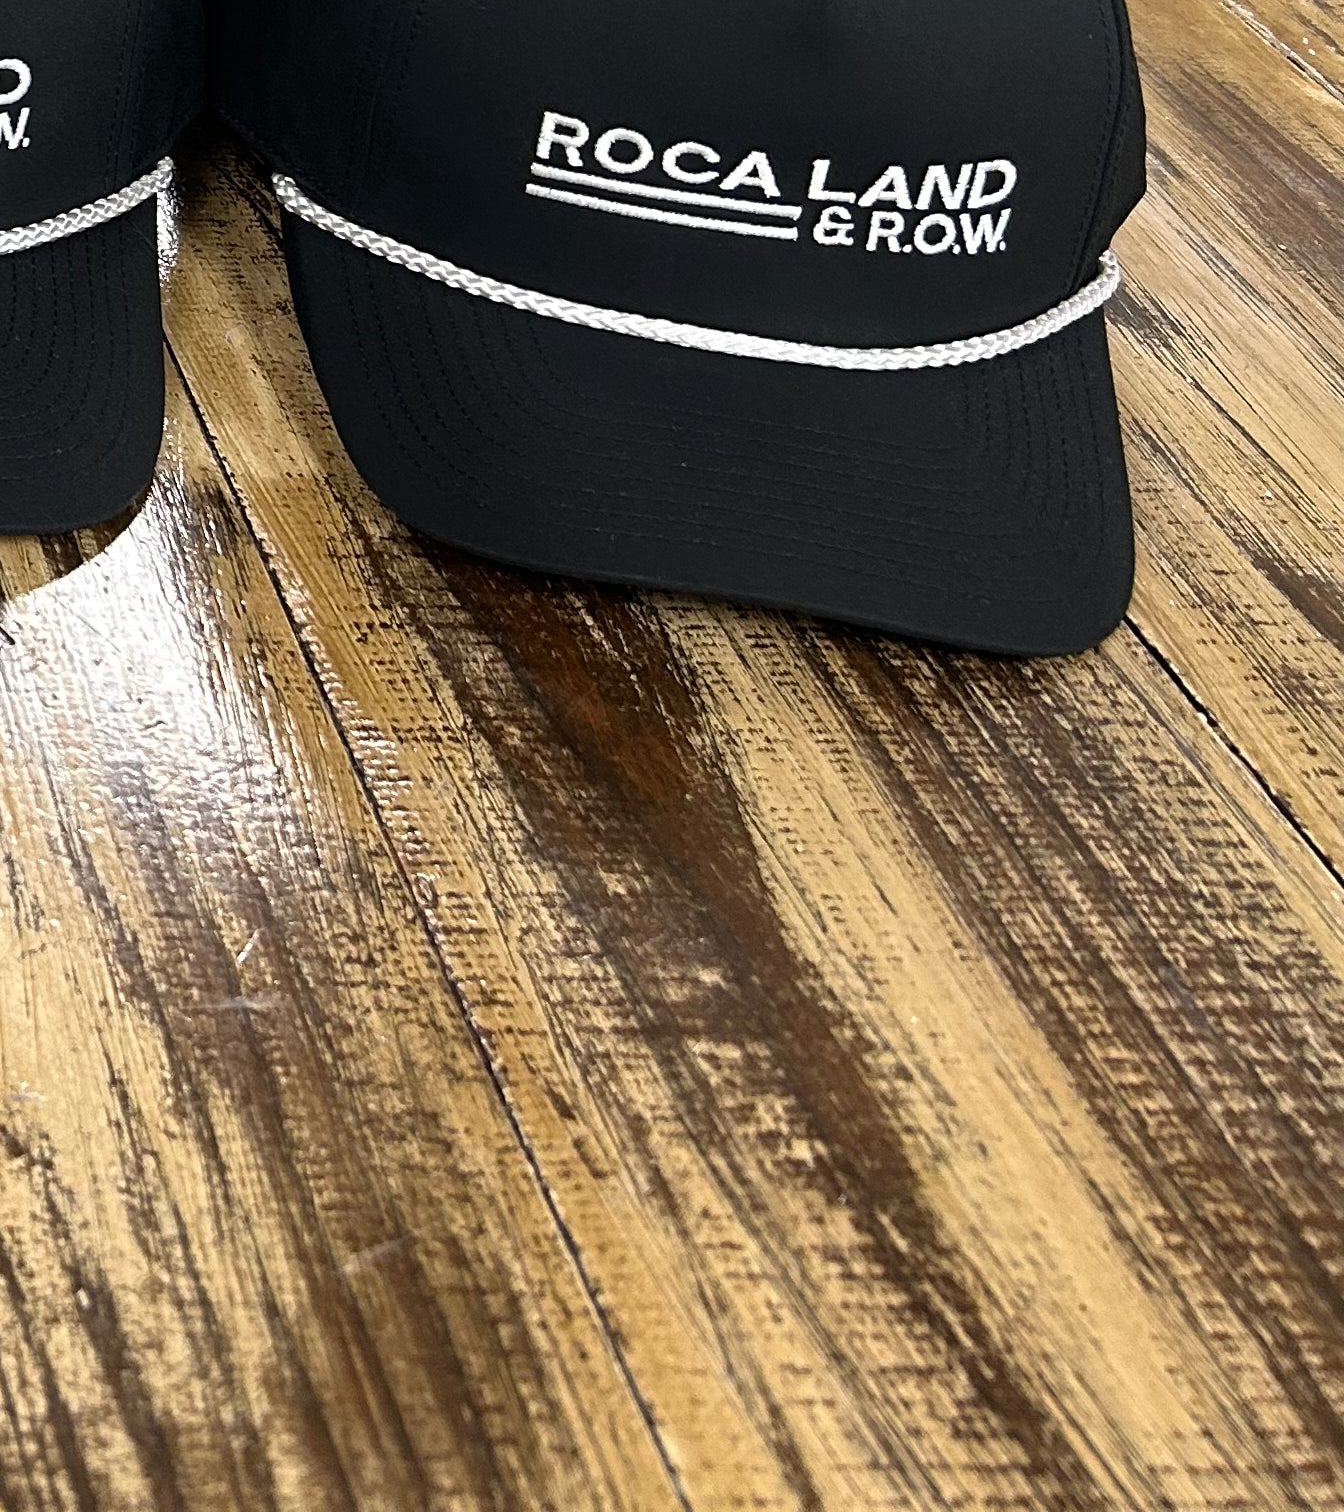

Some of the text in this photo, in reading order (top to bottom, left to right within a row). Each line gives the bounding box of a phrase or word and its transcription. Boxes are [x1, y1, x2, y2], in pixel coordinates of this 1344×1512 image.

[535, 111, 1018, 211] ROCA LAND
[812, 205, 1012, 255] & R.O.W.
